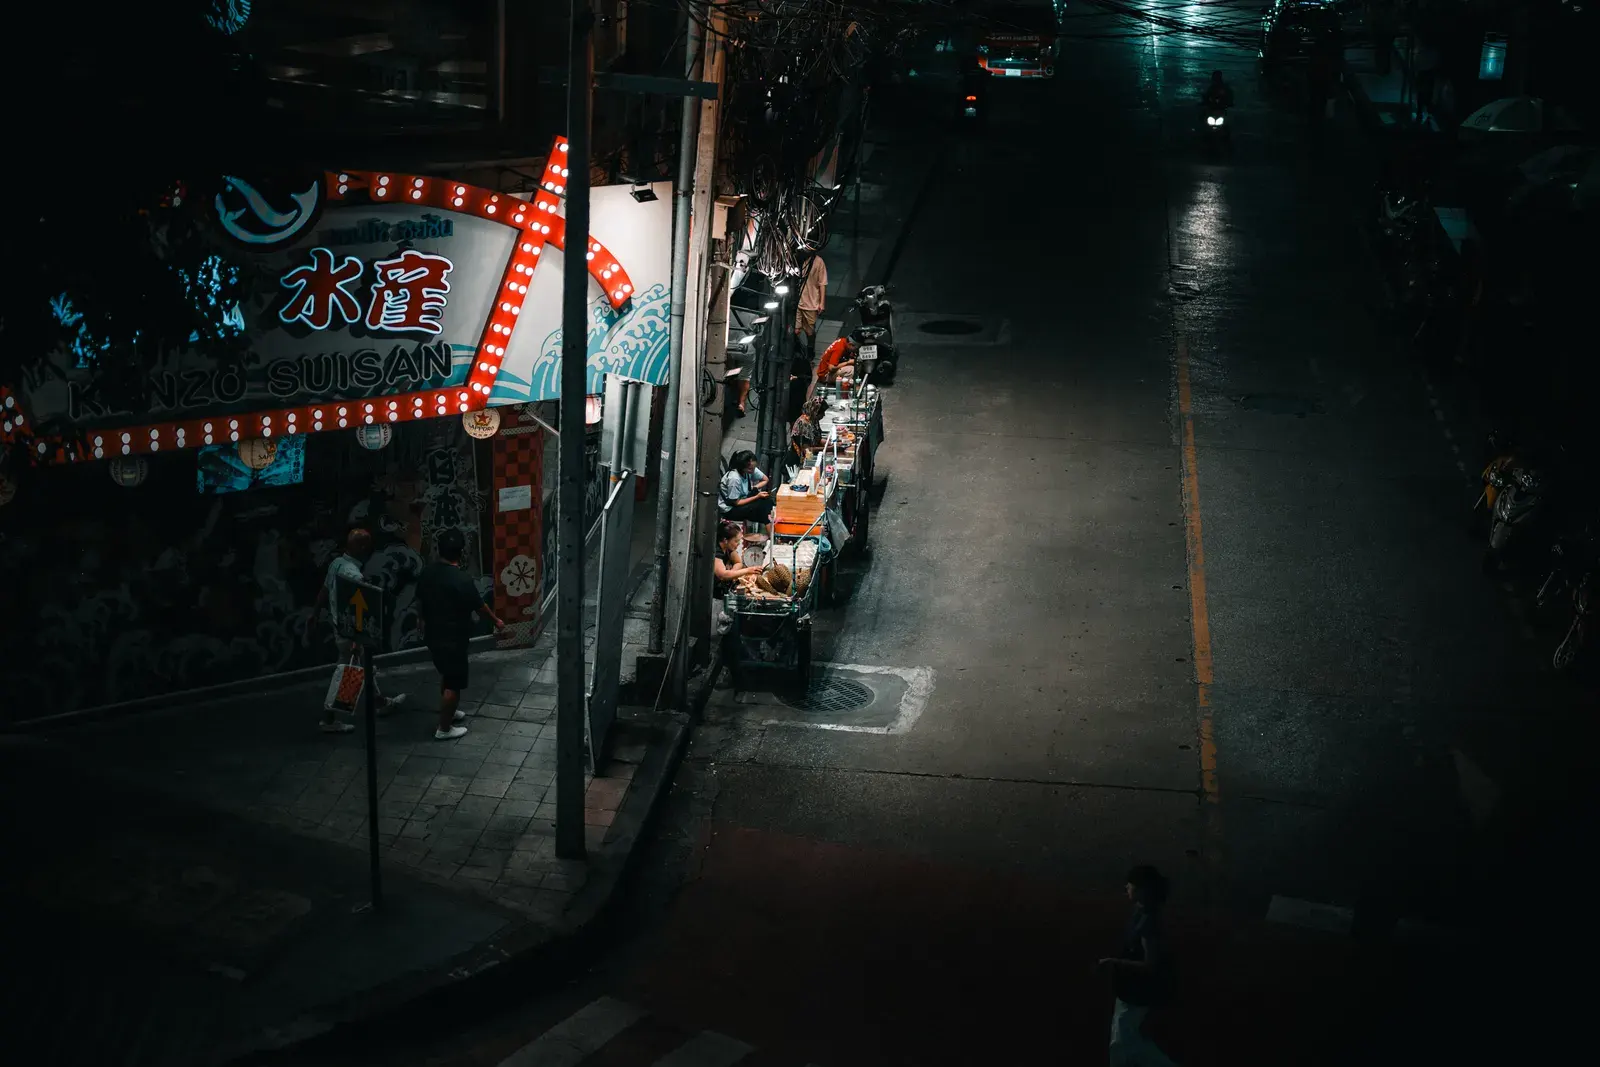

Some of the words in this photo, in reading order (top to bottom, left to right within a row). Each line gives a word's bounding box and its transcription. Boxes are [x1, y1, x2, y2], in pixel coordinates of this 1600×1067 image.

[278, 247, 453, 335] 水産
[67, 365, 247, 420] KNZO
[267, 341, 452, 398] SUISAN
